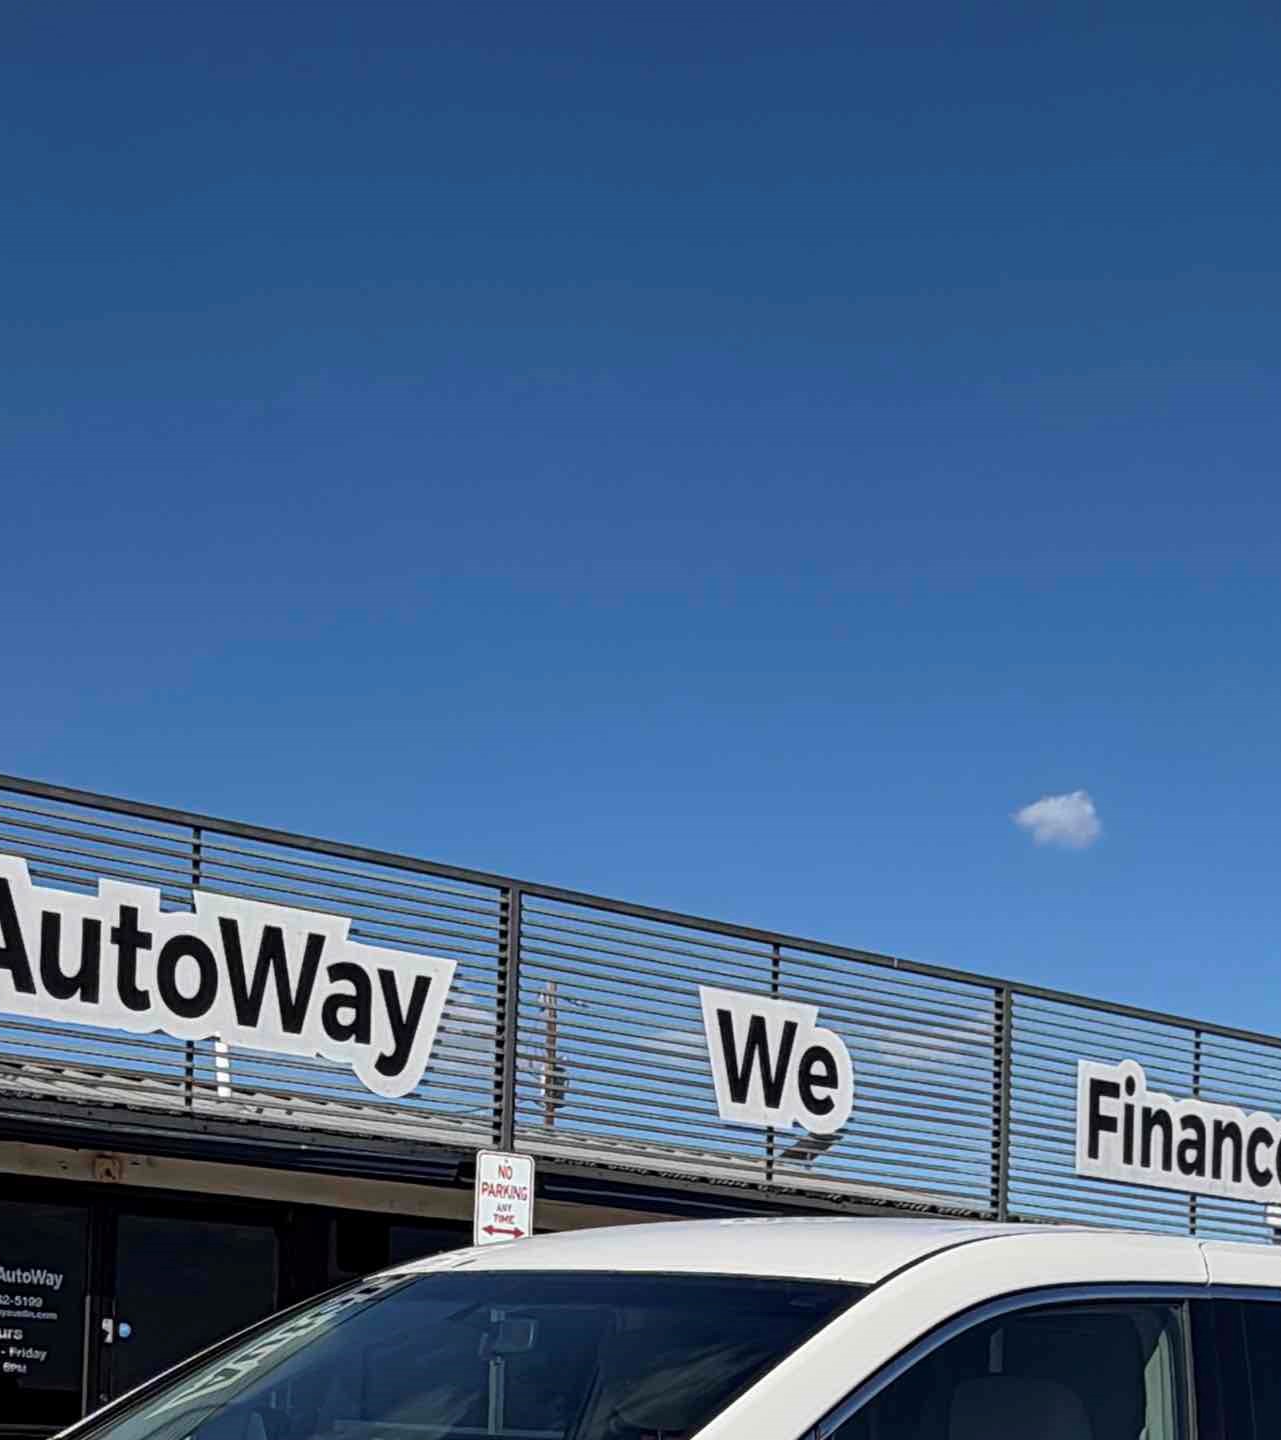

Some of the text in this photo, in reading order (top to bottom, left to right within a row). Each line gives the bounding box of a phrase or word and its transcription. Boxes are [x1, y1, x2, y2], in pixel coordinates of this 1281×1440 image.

[716, 1008, 839, 1117] We
[497, 1164, 513, 1180] NO
[481, 1182, 528, 1201] PARKING
[496, 1204, 512, 1213] ANY
[493, 1214, 515, 1225] TIME
[9, 1346, 47, 1362] Friday
